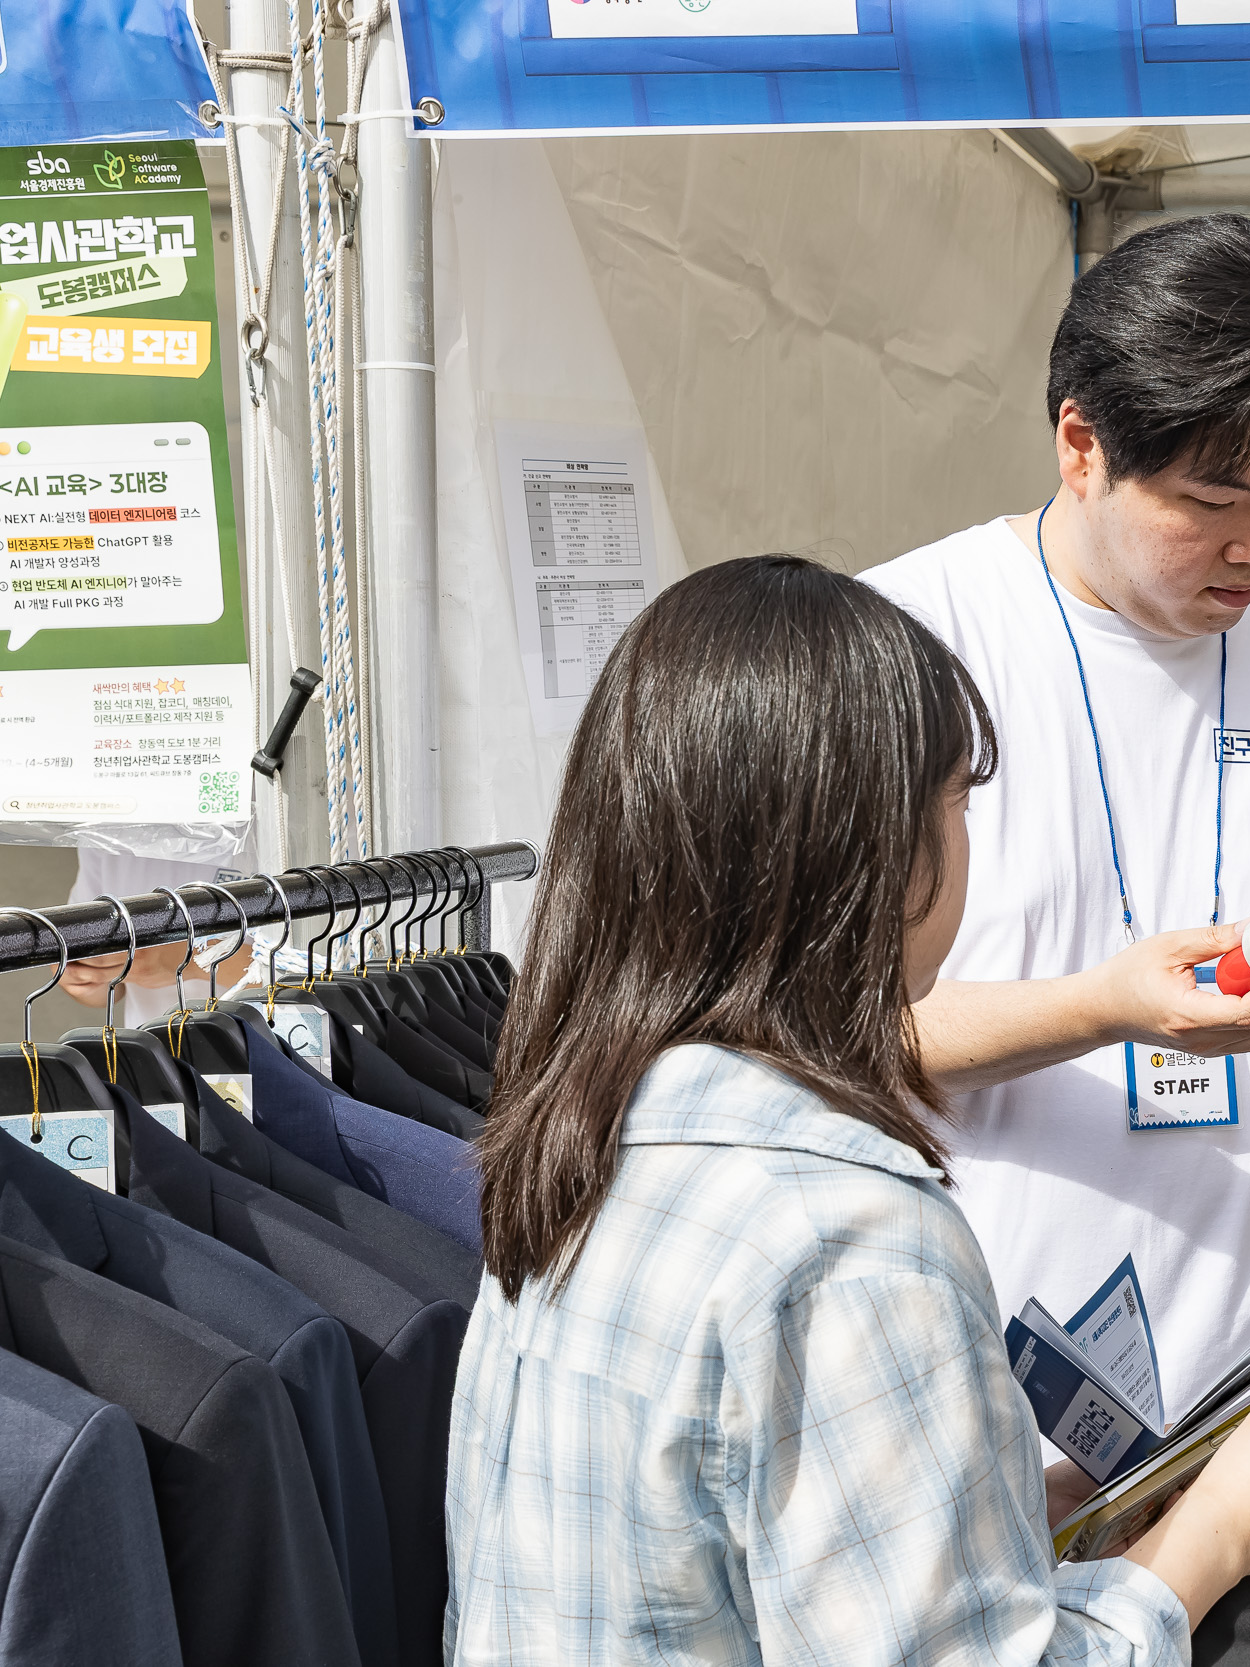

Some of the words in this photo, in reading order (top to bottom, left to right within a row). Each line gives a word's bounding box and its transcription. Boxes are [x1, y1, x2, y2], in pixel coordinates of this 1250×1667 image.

[27, 151, 70, 175] sba
[128, 153, 158, 163] Seoul
[131, 163, 177, 174] Software
[20, 177, 86, 192] 서울경제진흥원
[134, 174, 181, 185] ACademy
[0, 215, 197, 265] 업사관학교
[37, 263, 161, 309] 도봉캠퍼스
[27, 326, 125, 364] 교육생
[132, 329, 197, 365] 모집
[46, 473, 102, 497] 교육>
[109, 471, 168, 494] 3대장
[4, 513, 36, 524] NEXT
[89, 509, 121, 522] 데이터
[123, 507, 177, 521] 엔지니어링
[180, 508, 201, 519] 코스
[7, 538, 60, 551] 비전공자도
[62, 536, 94, 549] 가능한
[97, 536, 150, 548] ChatGPT
[152, 534, 174, 547] 활용
[9, 558, 21, 569] AI
[24, 557, 55, 570] 개발자
[58, 556, 101, 569] 양성과정
[11, 579, 33, 592] 현업
[35, 578, 68, 591] 반도체
[70, 579, 83, 590] AI
[84, 577, 138, 590] 엔지니어가
[14, 599, 26, 610] AI
[28, 598, 49, 610] 개발
[52, 597, 73, 609] Full
[75, 597, 100, 609] PKG
[102, 596, 124, 608] 과정
[92, 682, 130, 694] 새싹만의
[132, 681, 151, 693] 혜택
[93, 699, 112, 711] 점심
[113, 699, 133, 710] 식대
[134, 698, 156, 711] 지원,
[192, 696, 233, 708] 매칭데이,
[93, 713, 172, 725] 이력서/포트폴리오
[173, 712, 192, 723] 제작
[194, 711, 213, 722] 지원
[214, 711, 225, 721] 등
[93, 739, 133, 750] 교육장소
[138, 738, 165, 750] 창동역
[167, 737, 186, 748] 도보
[187, 737, 201, 748] 1분
[203, 736, 221, 747] 거리
[93, 755, 171, 768] 청년취업사관학교
[173, 754, 221, 766] 도봉캠퍼스
[288, 1024, 309, 1050] C
[1154, 1078, 1209, 1095] STAFF
[67, 1134, 93, 1161] C
[1079, 1399, 1116, 1438] 진구네
[1066, 1421, 1101, 1458] 편의점
